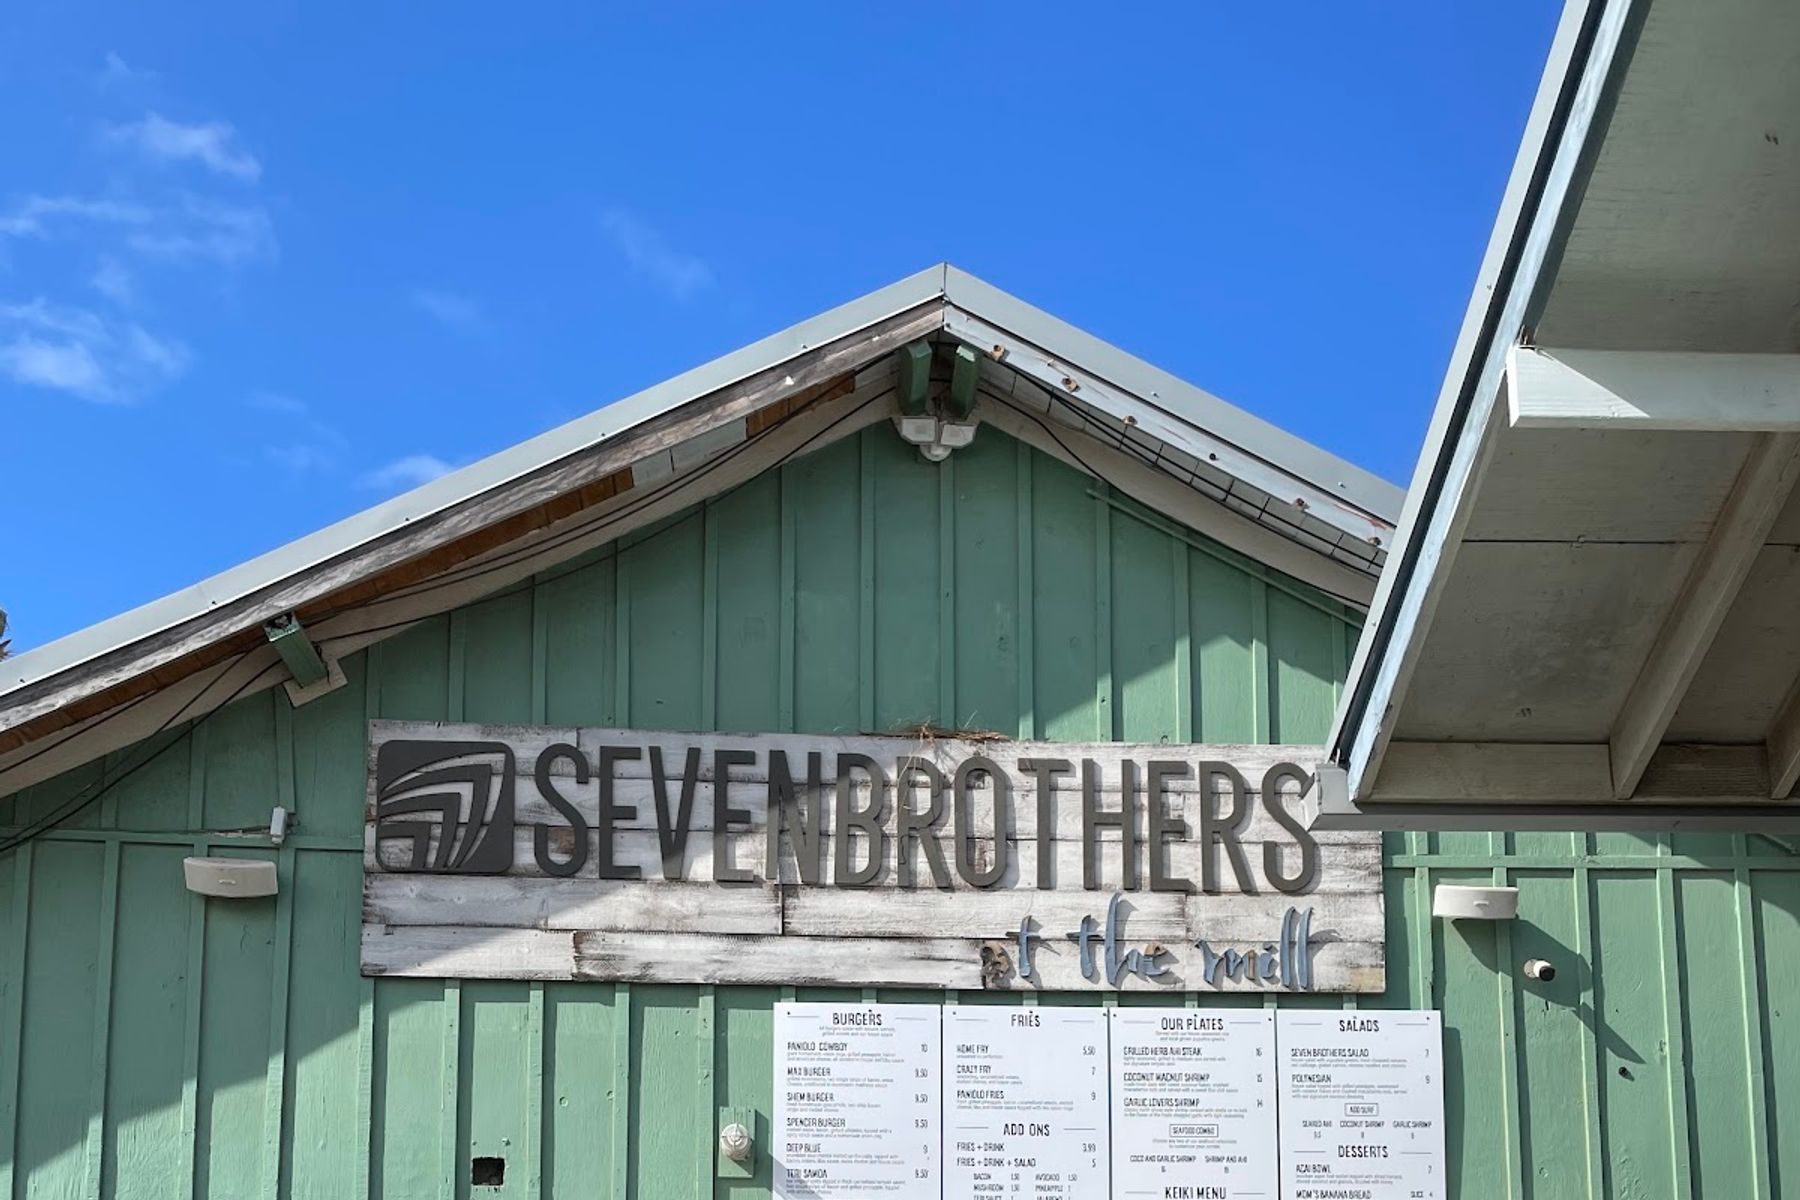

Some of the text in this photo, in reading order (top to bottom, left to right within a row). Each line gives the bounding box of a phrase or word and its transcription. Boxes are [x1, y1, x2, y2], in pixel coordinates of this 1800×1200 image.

[1066, 892, 1169, 989] the
[1195, 906, 1316, 990] mill
[832, 1012, 882, 1026] BURGERS
[1011, 1014, 1040, 1027] FRIES
[1161, 1017, 1224, 1031] OUR PLATES
[1339, 1020, 1380, 1032] SALADS
[977, 1044, 989, 1054] FRY
[1124, 1047, 1150, 1056] GRILLED
[1150, 1047, 1168, 1056] HERB
[1182, 1048, 1202, 1056] STEAK
[1291, 1049, 1312, 1057] SEVEN
[1313, 1049, 1347, 1057] BROTHERS
[1348, 1049, 1369, 1057] SALAD
[803, 1068, 831, 1076] BURGER
[956, 1065, 978, 1074] CRAZY
[979, 1065, 991, 1074] FRY
[1124, 1073, 1155, 1081] COCONUT
[1184, 1073, 1210, 1082] SHRIMP
[1292, 1074, 1332, 1083] POLYNESIAN
[807, 1093, 834, 1102] BURGER
[986, 1090, 1004, 1099] FRIES
[1124, 1098, 1148, 1106] GARLIC
[1149, 1098, 1174, 1107] LOVERS
[1174, 1098, 1200, 1107] SHRIMP
[787, 1118, 817, 1127] SPENCER
[818, 1118, 846, 1127] BURGER
[1365, 1120, 1385, 1128] SHRIMP
[1003, 1123, 1050, 1137] ADD ONS
[786, 1144, 803, 1152] DEEP
[804, 1144, 821, 1152] BLUE
[957, 1142, 975, 1151] FRIES
[984, 1143, 1004, 1151] DRINK
[1338, 1145, 1388, 1158] DESSERTS
[957, 1157, 975, 1166] FRIES
[984, 1158, 1004, 1166] DRINK
[1014, 1158, 1036, 1167] SALAD
[1312, 1164, 1331, 1173] BOWL
[1165, 1186, 1226, 1200] KEIKI MENU
[1320, 1191, 1348, 1199] BANANA
[1349, 1190, 1372, 1199] BREAD
